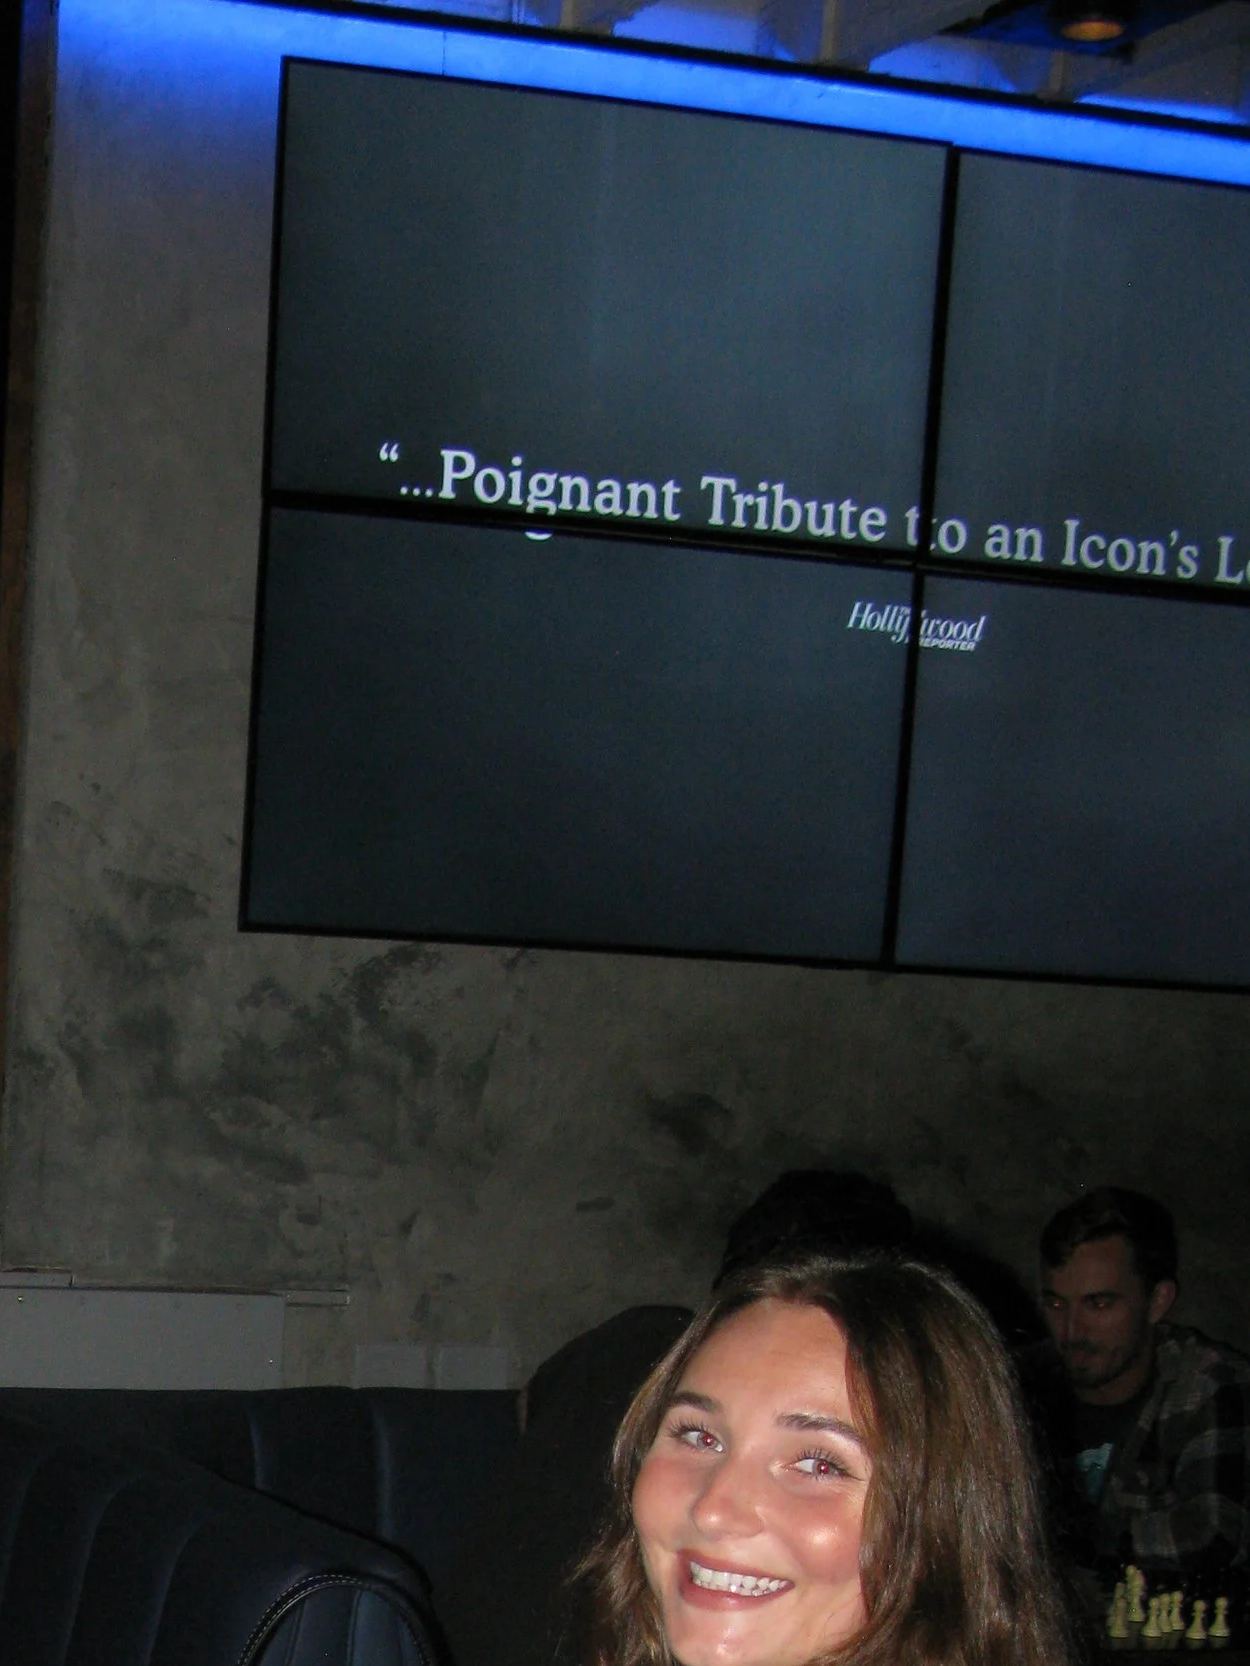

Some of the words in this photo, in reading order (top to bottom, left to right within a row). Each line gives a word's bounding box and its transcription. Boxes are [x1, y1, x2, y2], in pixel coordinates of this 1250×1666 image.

[700, 476, 888, 543] Tribute
[905, 506, 967, 554] to
[984, 524, 1044, 562] an
[1062, 519, 1199, 579] Icon's
[1214, 536, 1250, 586] L
[847, 602, 987, 643] Hollywood
